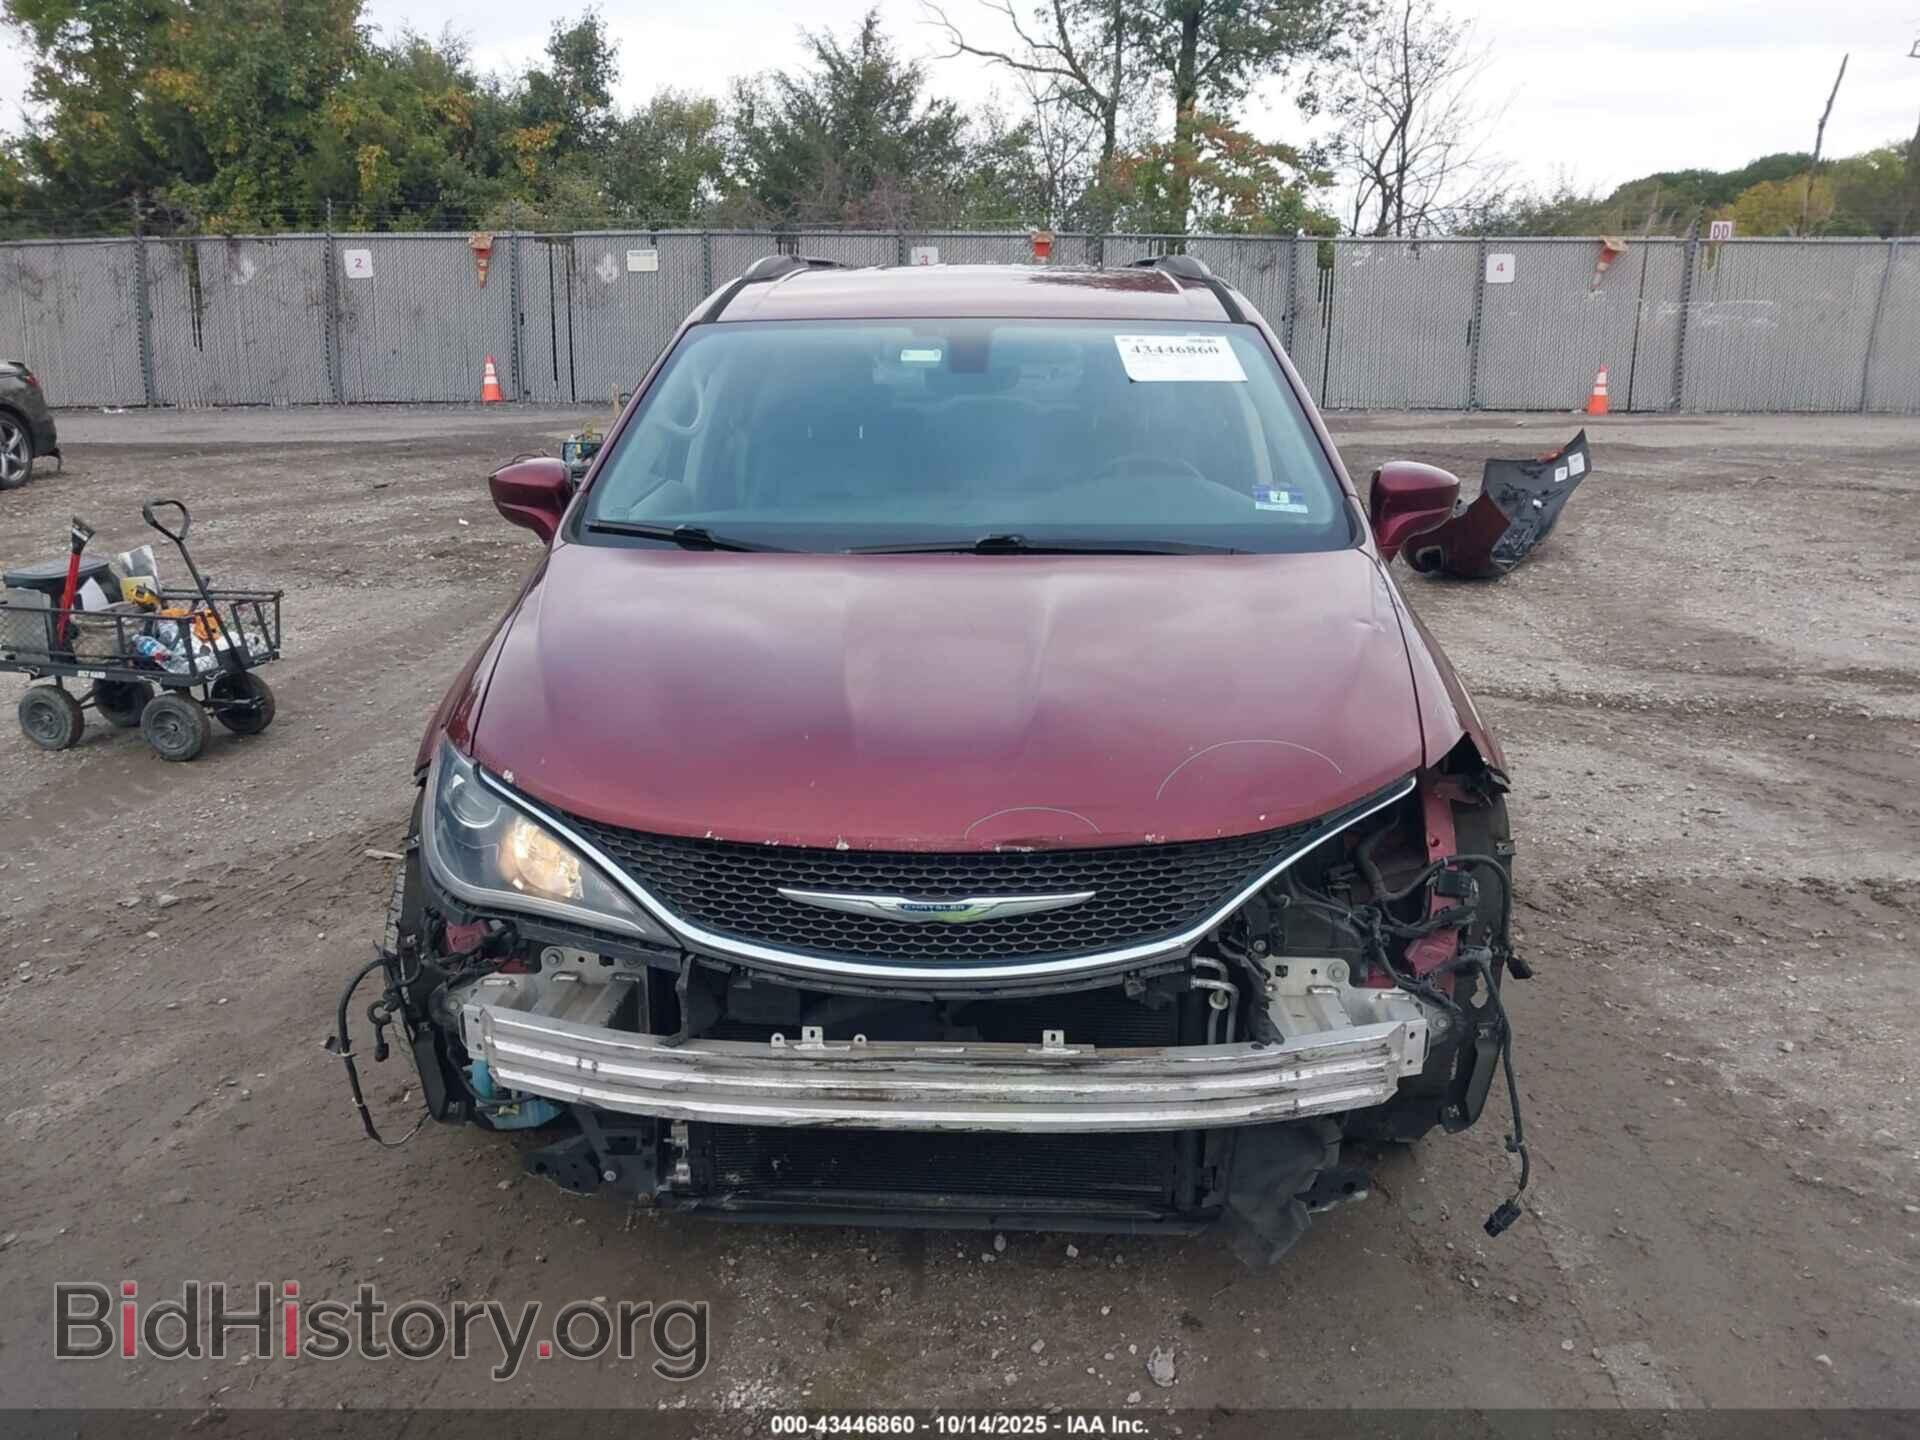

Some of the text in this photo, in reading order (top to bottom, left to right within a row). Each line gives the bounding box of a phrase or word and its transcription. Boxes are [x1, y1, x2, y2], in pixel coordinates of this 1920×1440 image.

[354, 257, 363, 268] 2
[1496, 262, 1505, 272] 4
[1131, 344, 1220, 354] 43446860
